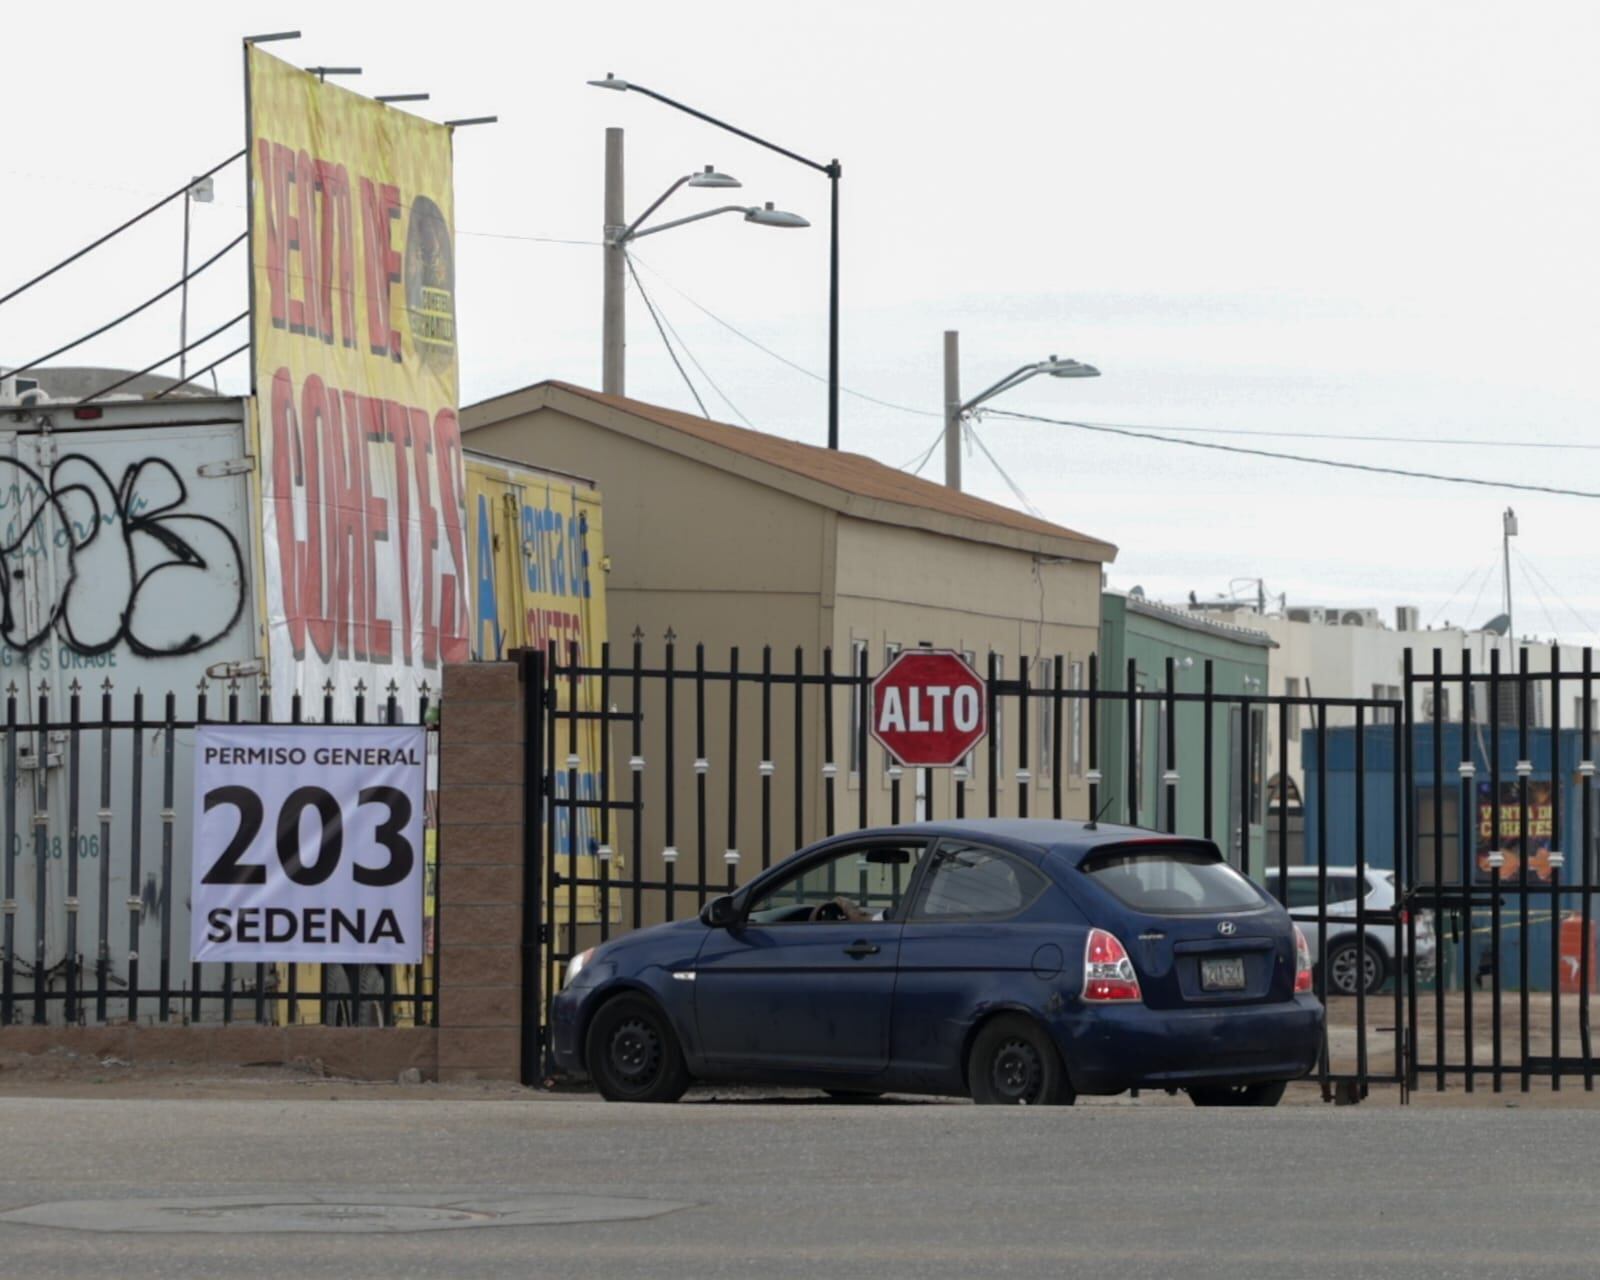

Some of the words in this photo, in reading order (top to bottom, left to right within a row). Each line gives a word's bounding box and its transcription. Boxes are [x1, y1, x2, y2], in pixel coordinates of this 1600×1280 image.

[271, 366, 471, 669] COHETES
[521, 504, 566, 596] enta
[39, 648, 117, 671] SORAGE
[525, 607, 584, 685] OHETES
[879, 684, 979, 732] ALTO
[204, 747, 306, 766] PERMISO
[313, 747, 421, 766] GENERAL
[200, 784, 414, 887] 203
[207, 907, 406, 944] SEDENA
